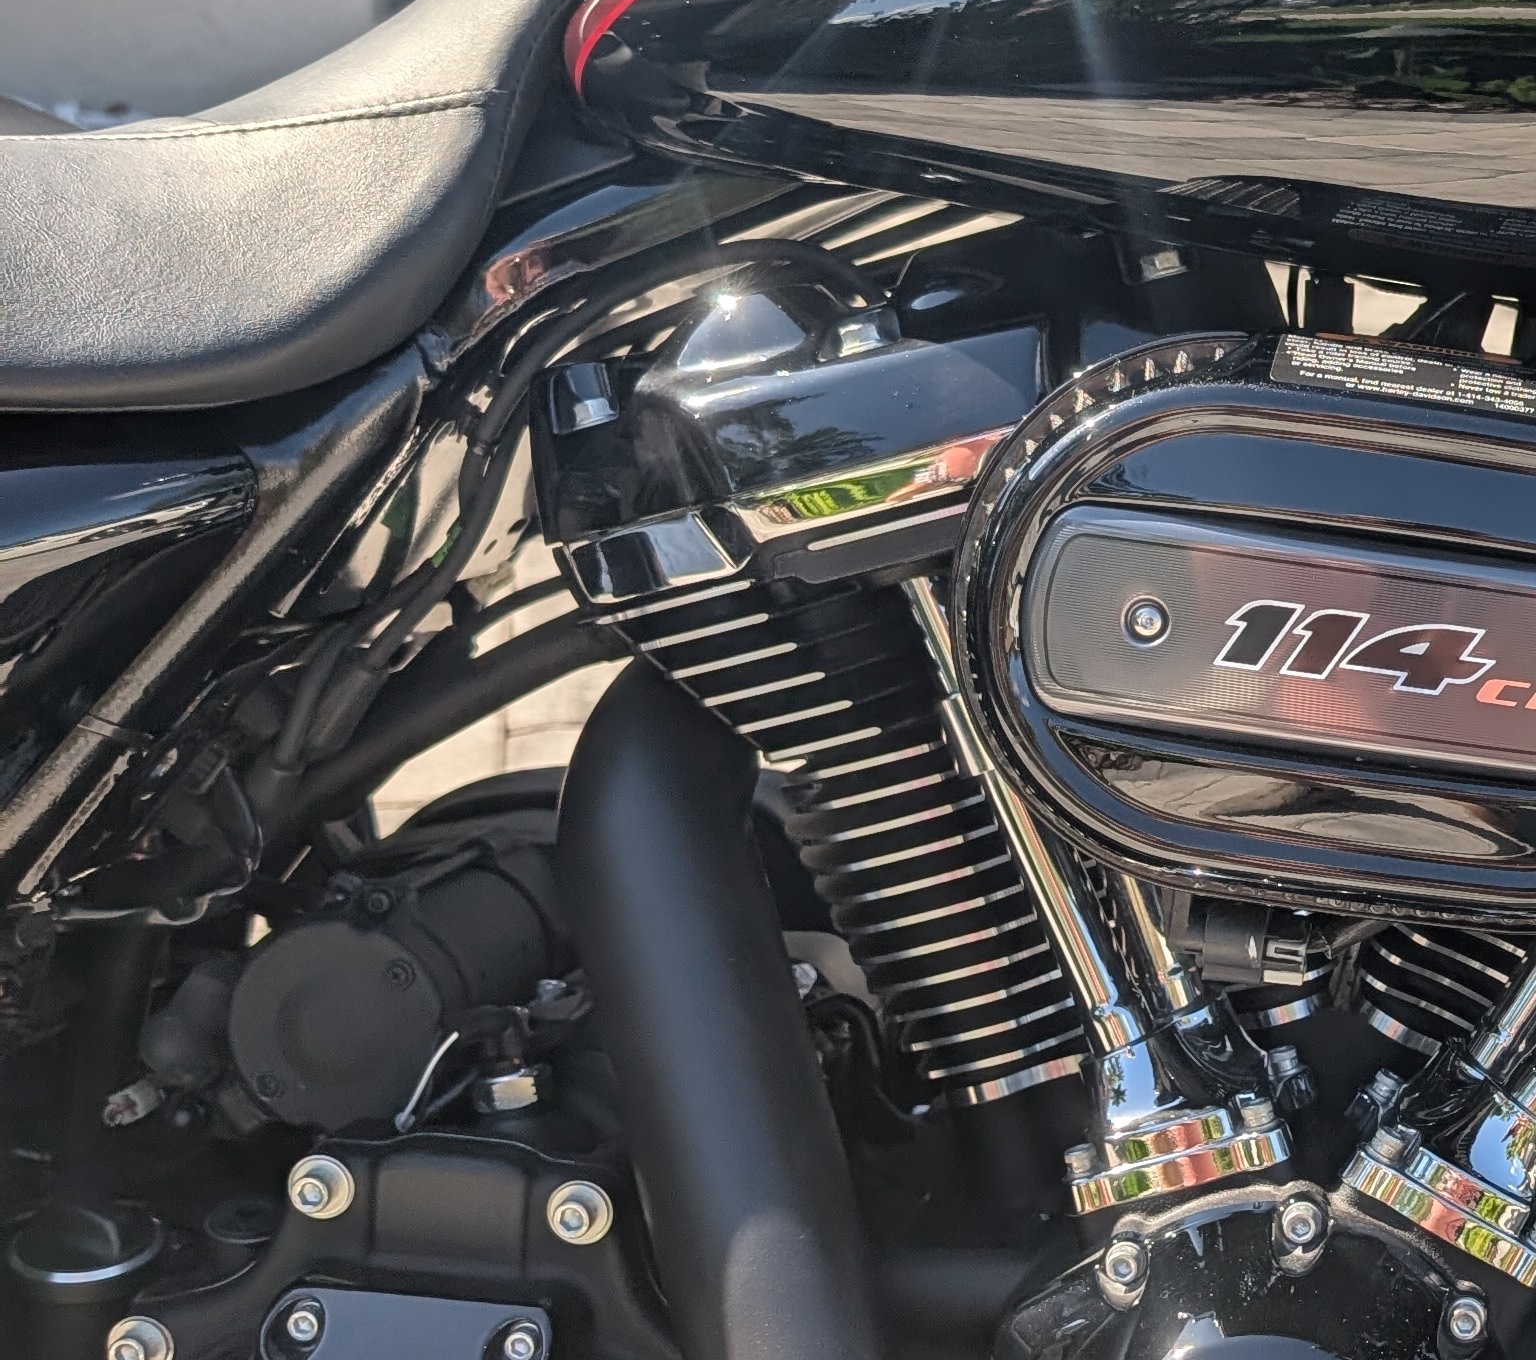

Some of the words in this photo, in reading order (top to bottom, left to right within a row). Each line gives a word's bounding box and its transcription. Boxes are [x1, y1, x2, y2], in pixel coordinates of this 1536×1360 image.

[1325, 374, 1359, 383] manual,
[1381, 381, 1414, 390] nearest
[1416, 386, 1444, 394] dealer
[1358, 384, 1474, 405] www.harley-davidson.com
[1213, 599, 1496, 696] 114
